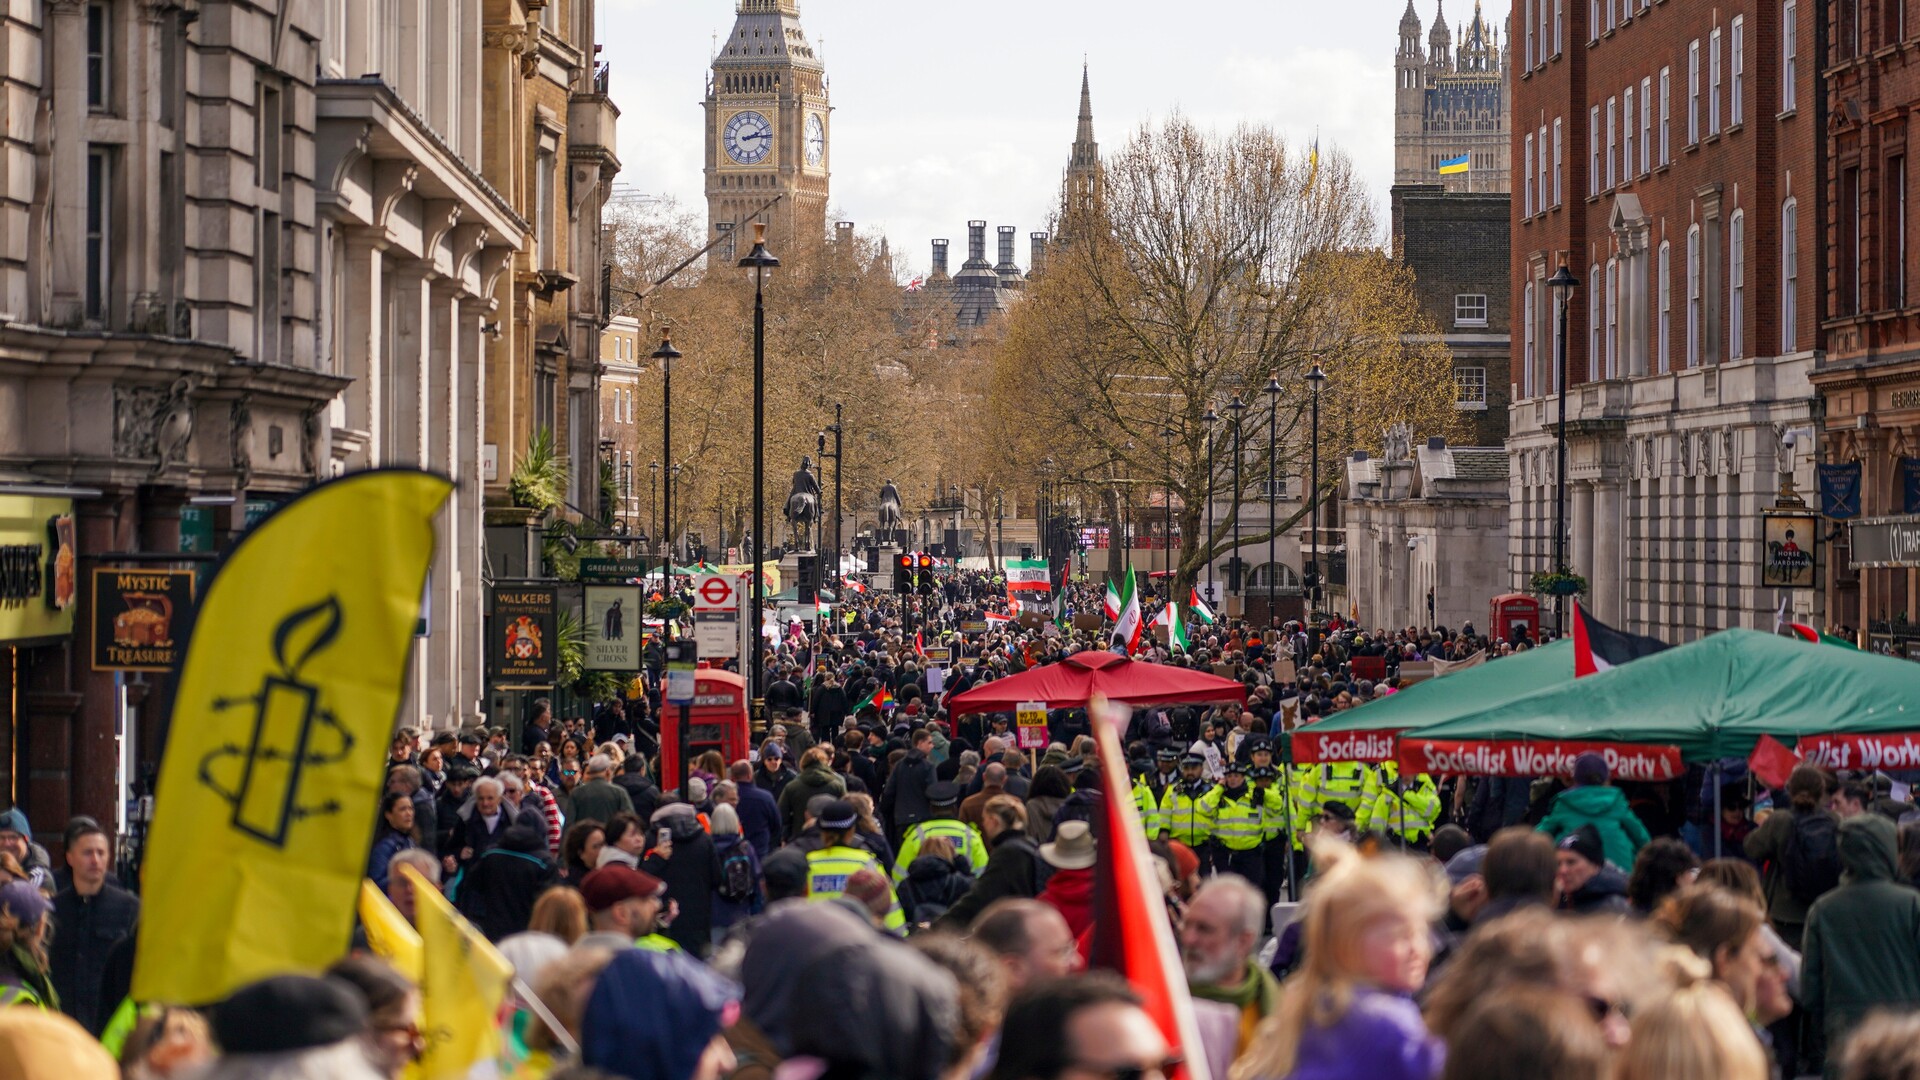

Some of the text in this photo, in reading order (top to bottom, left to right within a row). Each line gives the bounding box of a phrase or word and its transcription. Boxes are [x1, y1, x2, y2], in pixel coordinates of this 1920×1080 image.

[619, 565, 640, 573] KING
[117, 576, 171, 590] MYSTIC
[498, 594, 551, 604] WALKERS
[596, 645, 628, 654] SILVER
[596, 655, 628, 663] CROSS
[1318, 734, 1393, 760] Socialist
[1423, 742, 1506, 774] Socialist
[1603, 748, 1656, 780] Party
